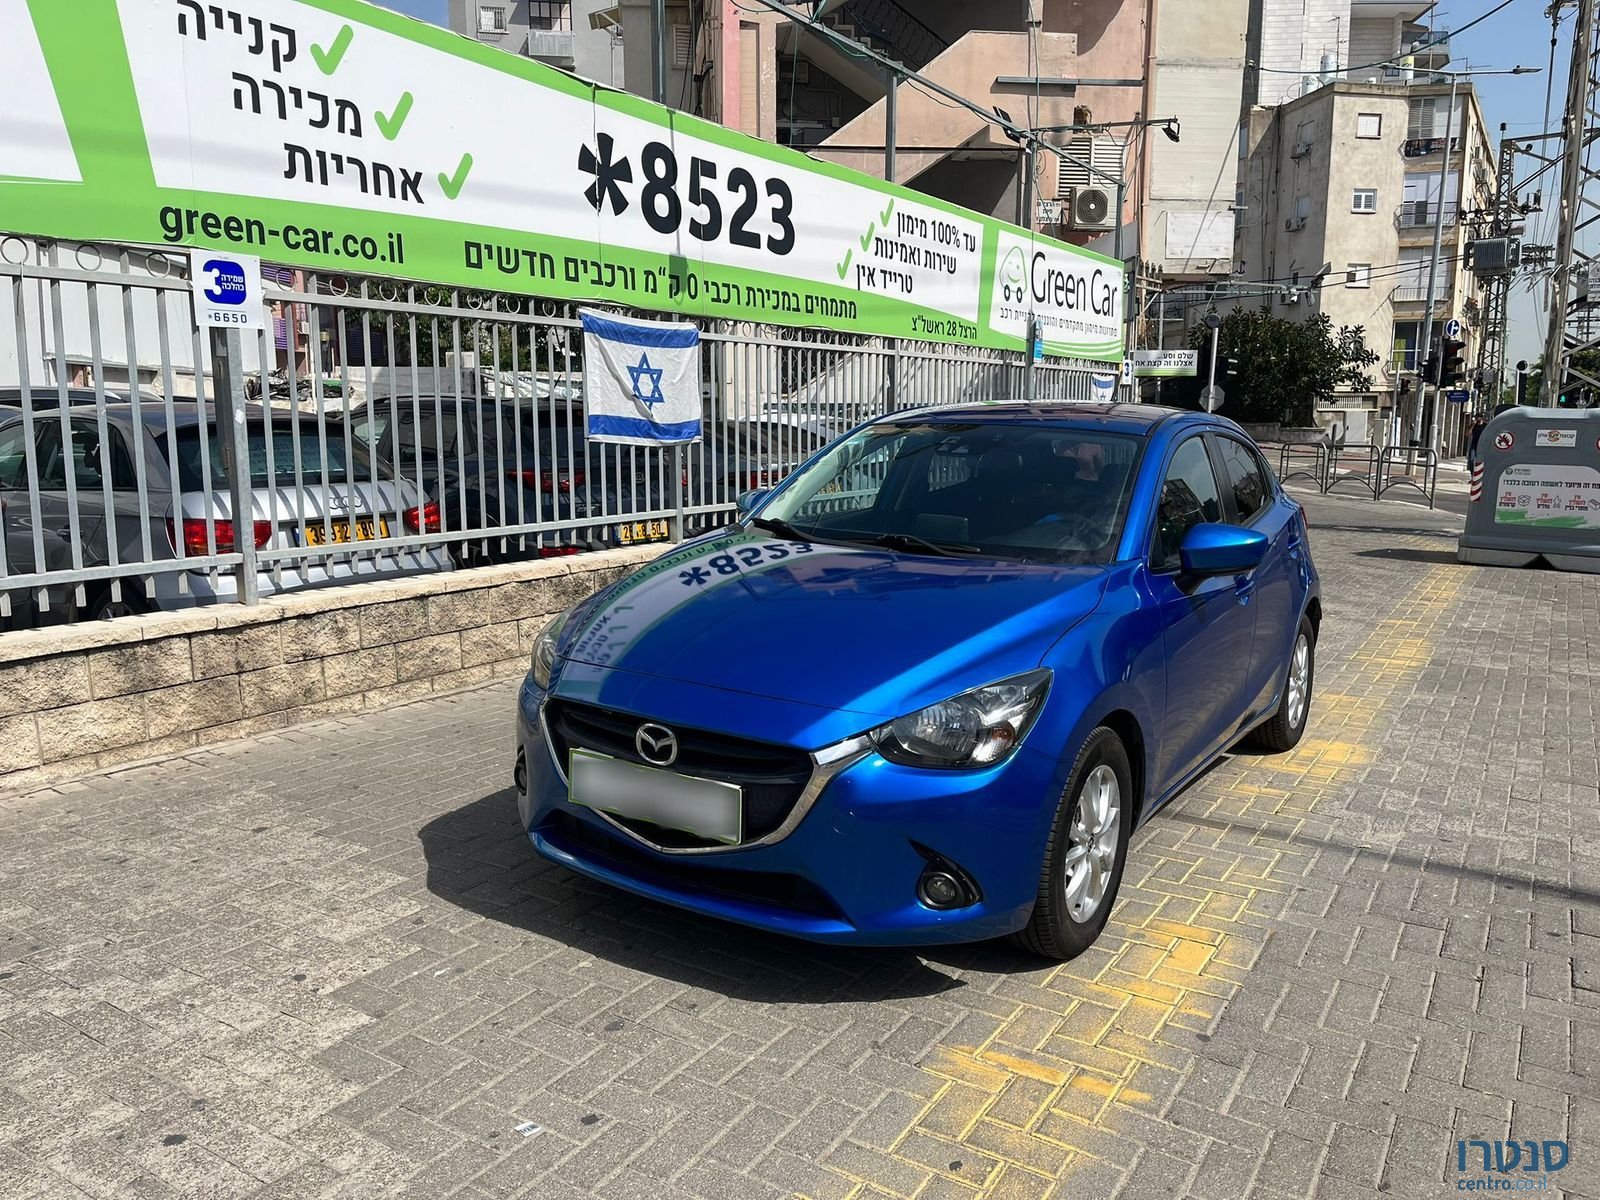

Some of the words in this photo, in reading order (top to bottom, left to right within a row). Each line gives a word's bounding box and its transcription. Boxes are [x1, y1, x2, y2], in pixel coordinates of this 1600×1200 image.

[176, 0, 298, 73] קנייה
[232, 71, 362, 138] מכירה
[283, 142, 425, 205] אחריות
[159, 205, 404, 264] green-car.co.il
[897, 212, 927, 239] מימון
[931, 220, 961, 248] 100%
[874, 236, 921, 266] ואמינות
[963, 232, 976, 253] עד
[464, 240, 556, 280] חדשים
[564, 256, 636, 291] ורכבים
[924, 249, 957, 275] שירות
[221, 274, 244, 283] שמירה
[221, 282, 245, 291] כהלכה
[856, 264, 876, 291] אין
[880, 269, 913, 294] טרייד
[1031, 251, 1086, 311] Green
[1091, 268, 1117, 317] Car
[704, 280, 741, 305] רכבי
[745, 285, 801, 313] במכירת
[805, 294, 857, 319] מתמחים
[947, 320, 957, 336] 28
[959, 321, 977, 340] הרצל
